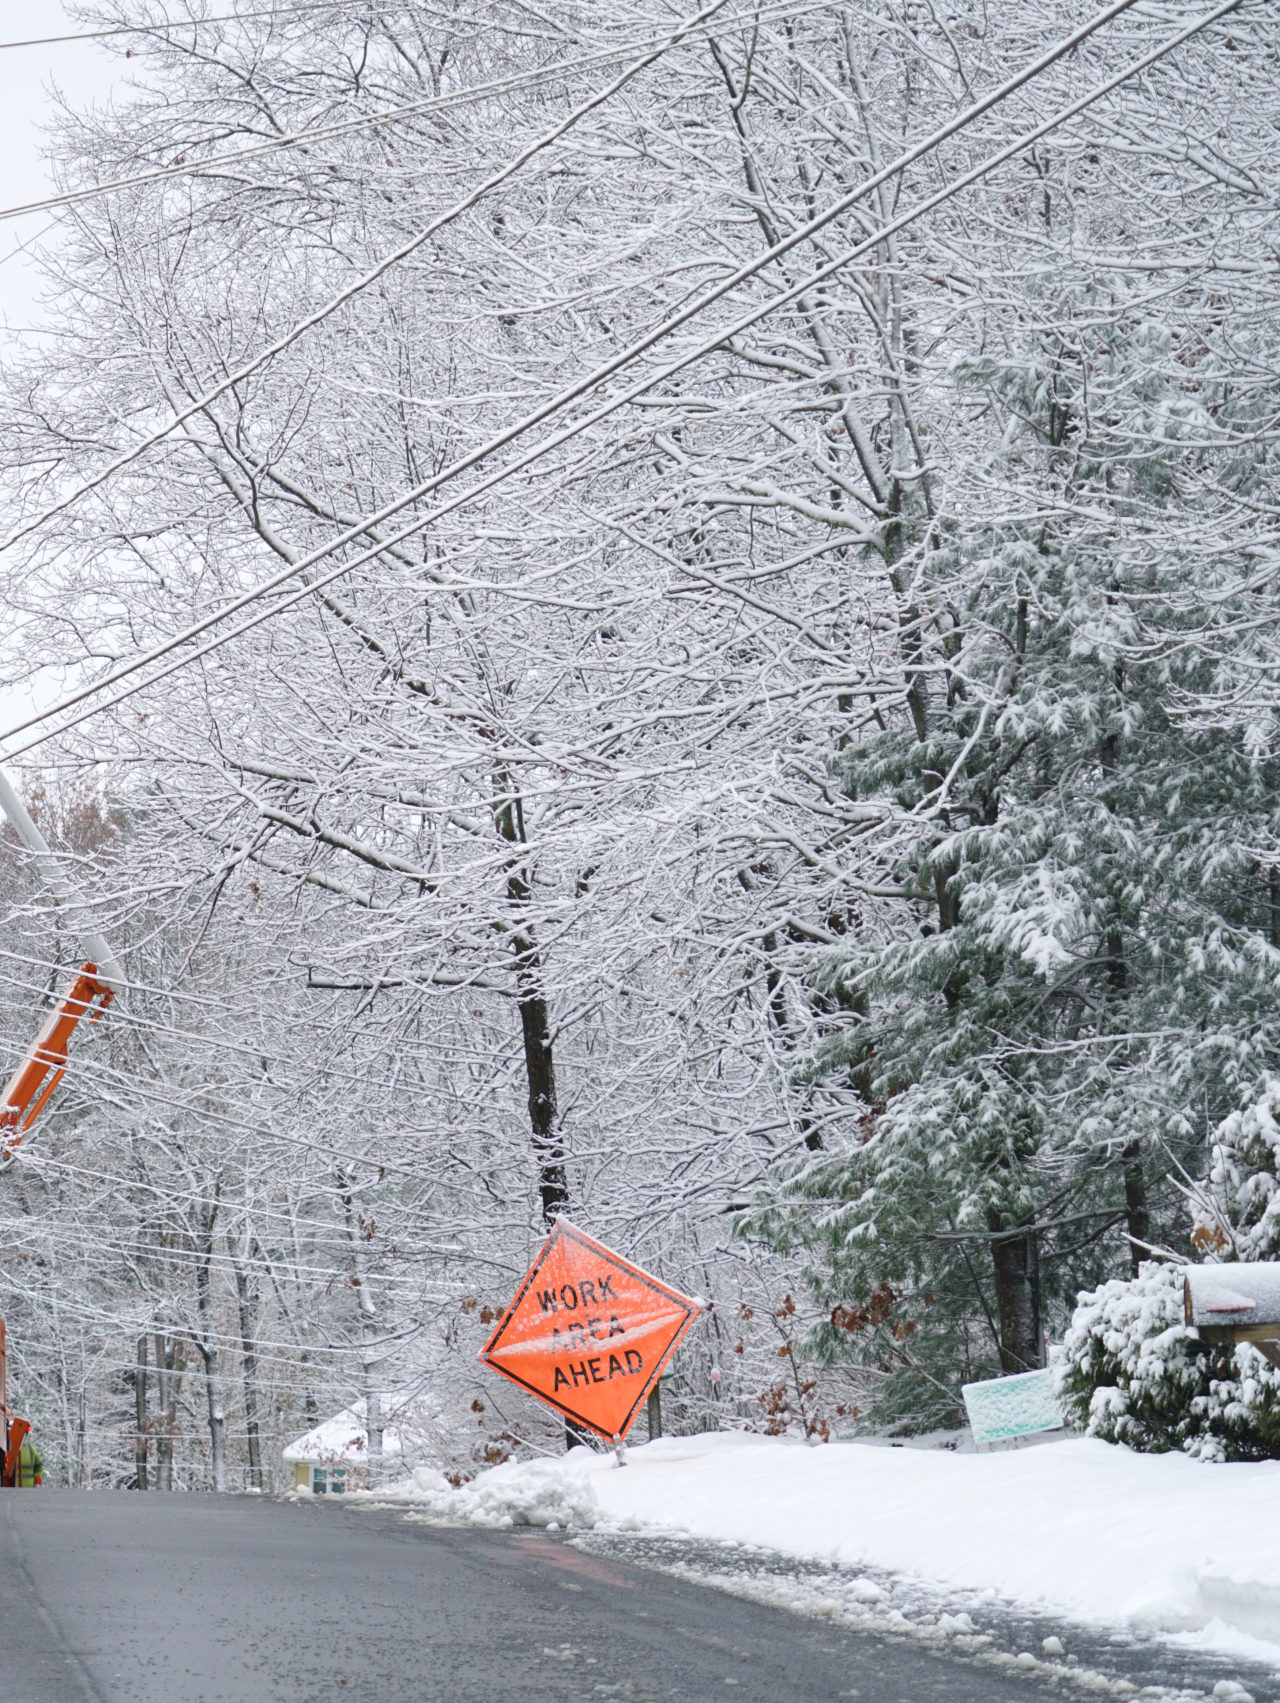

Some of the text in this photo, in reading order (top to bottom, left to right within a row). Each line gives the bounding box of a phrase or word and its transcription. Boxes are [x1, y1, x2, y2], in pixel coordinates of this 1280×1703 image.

[536, 1274, 619, 1313] WORK
[550, 1314, 626, 1354] AREA
[554, 1349, 644, 1393] AHEAD
